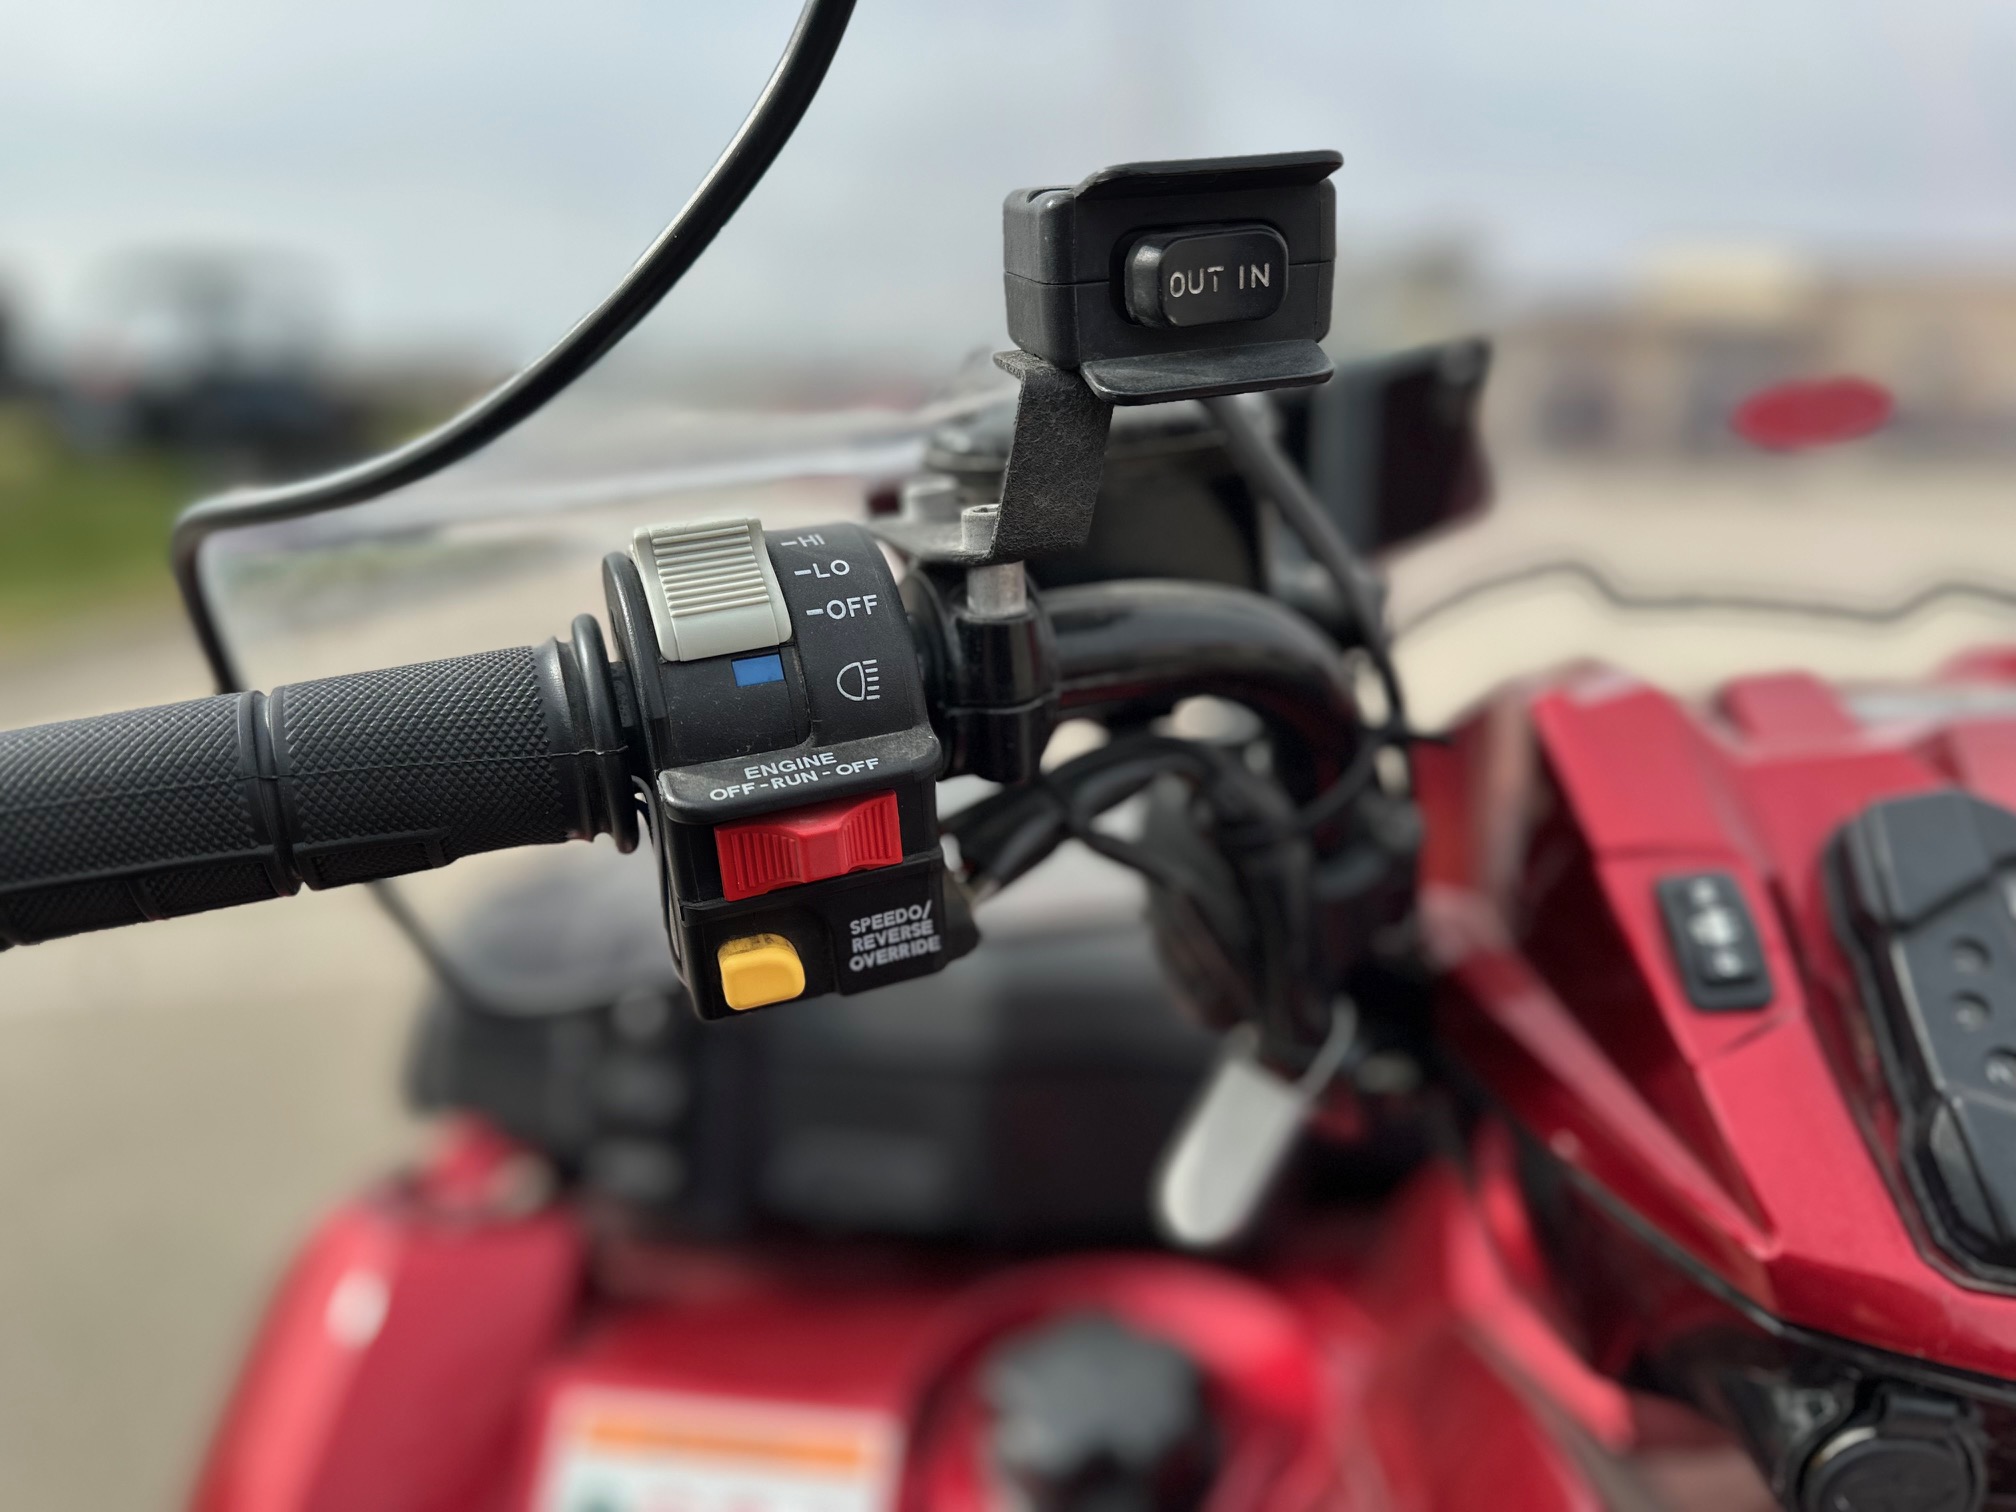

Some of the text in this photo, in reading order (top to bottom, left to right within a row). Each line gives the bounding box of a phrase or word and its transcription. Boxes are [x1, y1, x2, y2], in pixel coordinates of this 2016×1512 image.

[1169, 262, 1270, 298] OUT IN
[744, 752, 837, 780] ENGINE
[849, 899, 932, 935] SPEEDO/
[849, 934, 942, 972] OVERRIDE
[851, 919, 934, 954] REVERSE
